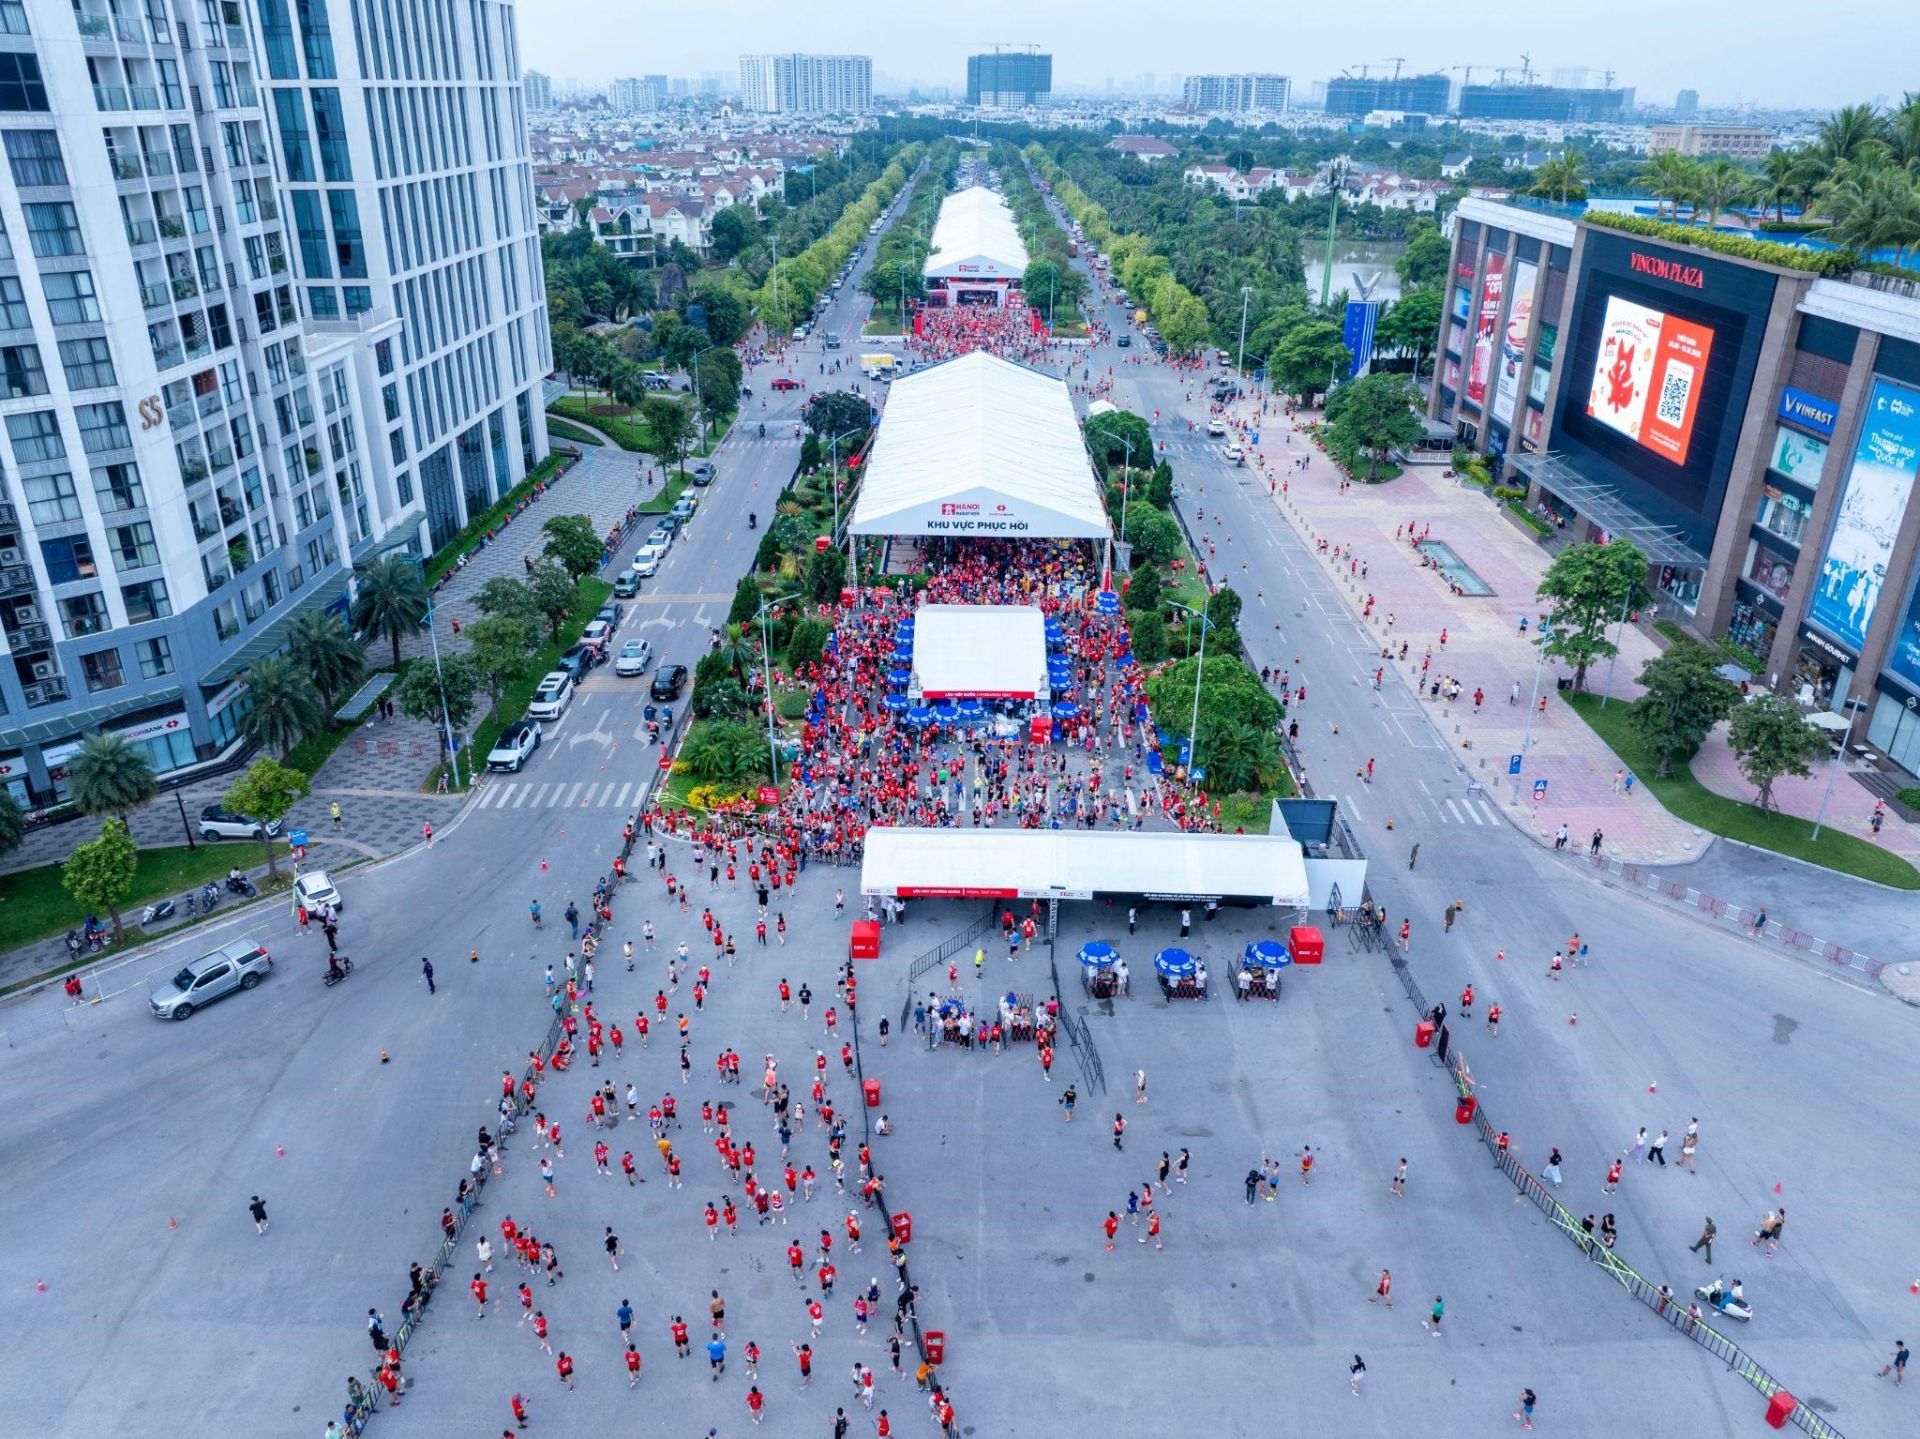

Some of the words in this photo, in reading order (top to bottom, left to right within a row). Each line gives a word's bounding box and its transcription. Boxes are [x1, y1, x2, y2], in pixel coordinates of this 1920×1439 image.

[1631, 252, 1669, 279] VINCOM
[1669, 263, 1704, 289] PLAZA
[138, 394, 163, 431] S5
[1795, 401, 1834, 426] VINFAST
[927, 521, 950, 529] KHU
[952, 520, 975, 531] VỰC
[977, 522, 1007, 532] PHỤC
[1009, 520, 1029, 530] HỒI
[1512, 756, 1520, 765] P
